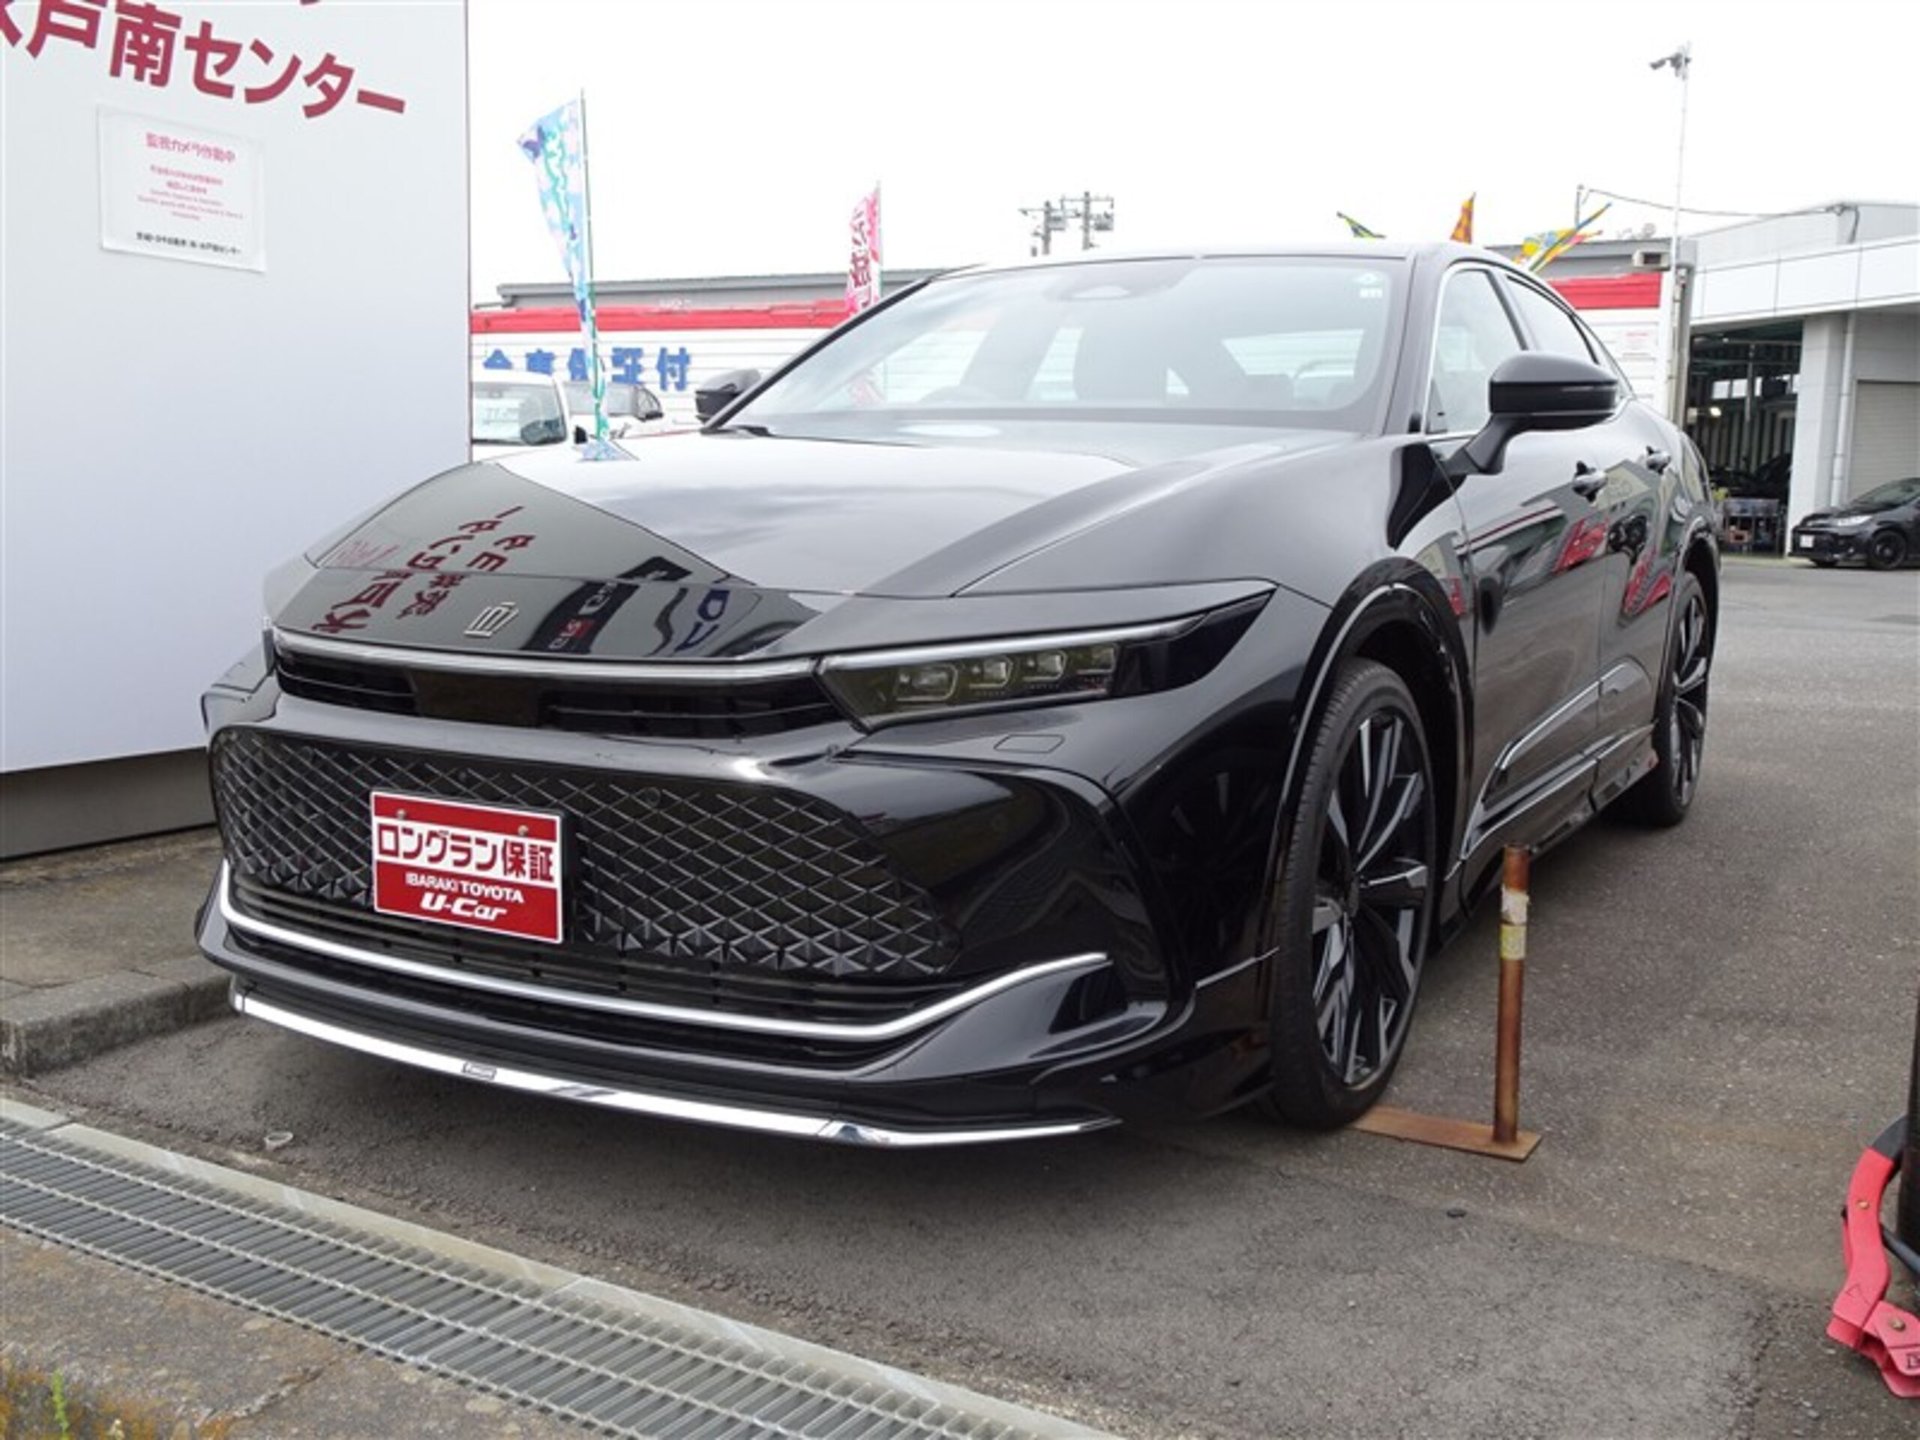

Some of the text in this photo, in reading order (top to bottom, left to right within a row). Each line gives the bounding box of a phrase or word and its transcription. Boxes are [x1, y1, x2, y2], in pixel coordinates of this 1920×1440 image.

[377, 823, 555, 882] ロングラン保証
[404, 872, 525, 904] IBARAKI TOYOTA
[420, 892, 507, 921] U-Car
